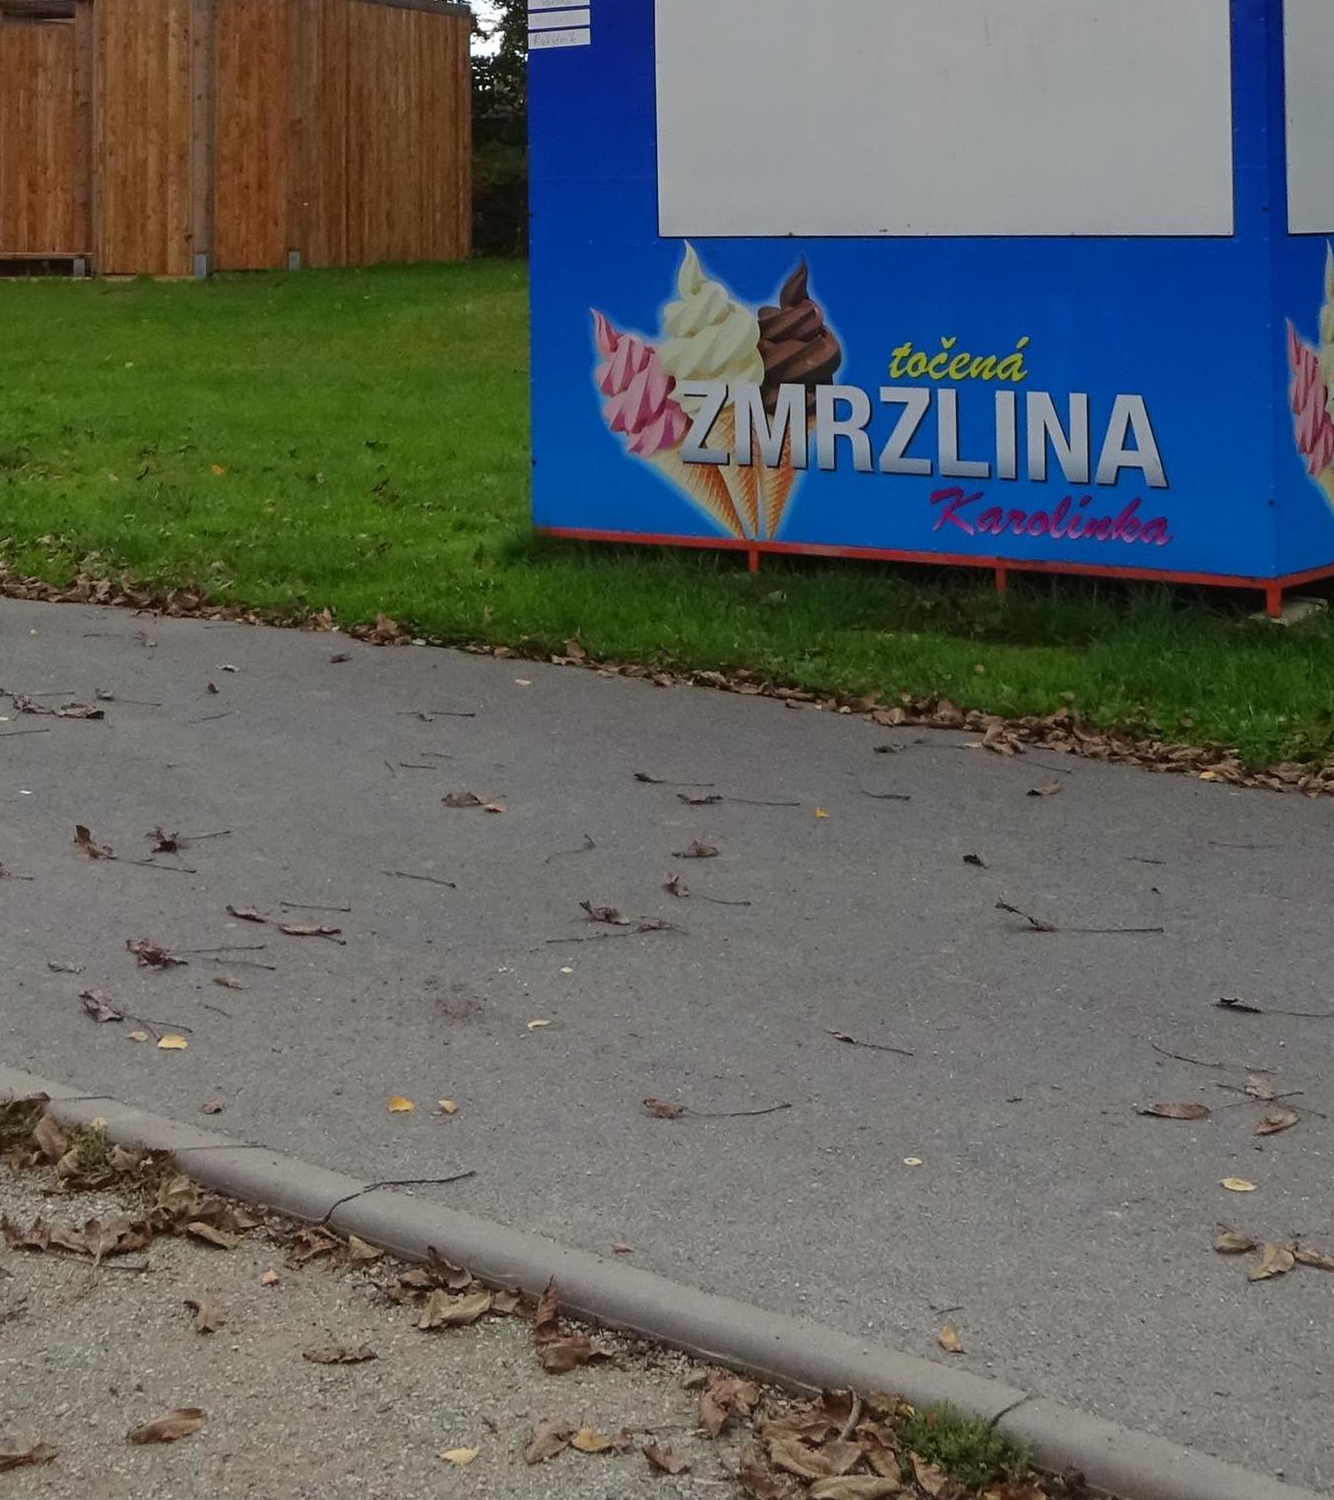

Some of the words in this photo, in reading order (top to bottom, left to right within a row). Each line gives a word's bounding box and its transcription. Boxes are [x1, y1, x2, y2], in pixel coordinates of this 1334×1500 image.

[888, 336, 1030, 383] točená
[680, 380, 1169, 490] ZMRZLINA
[929, 486, 1173, 546] Karolinka
